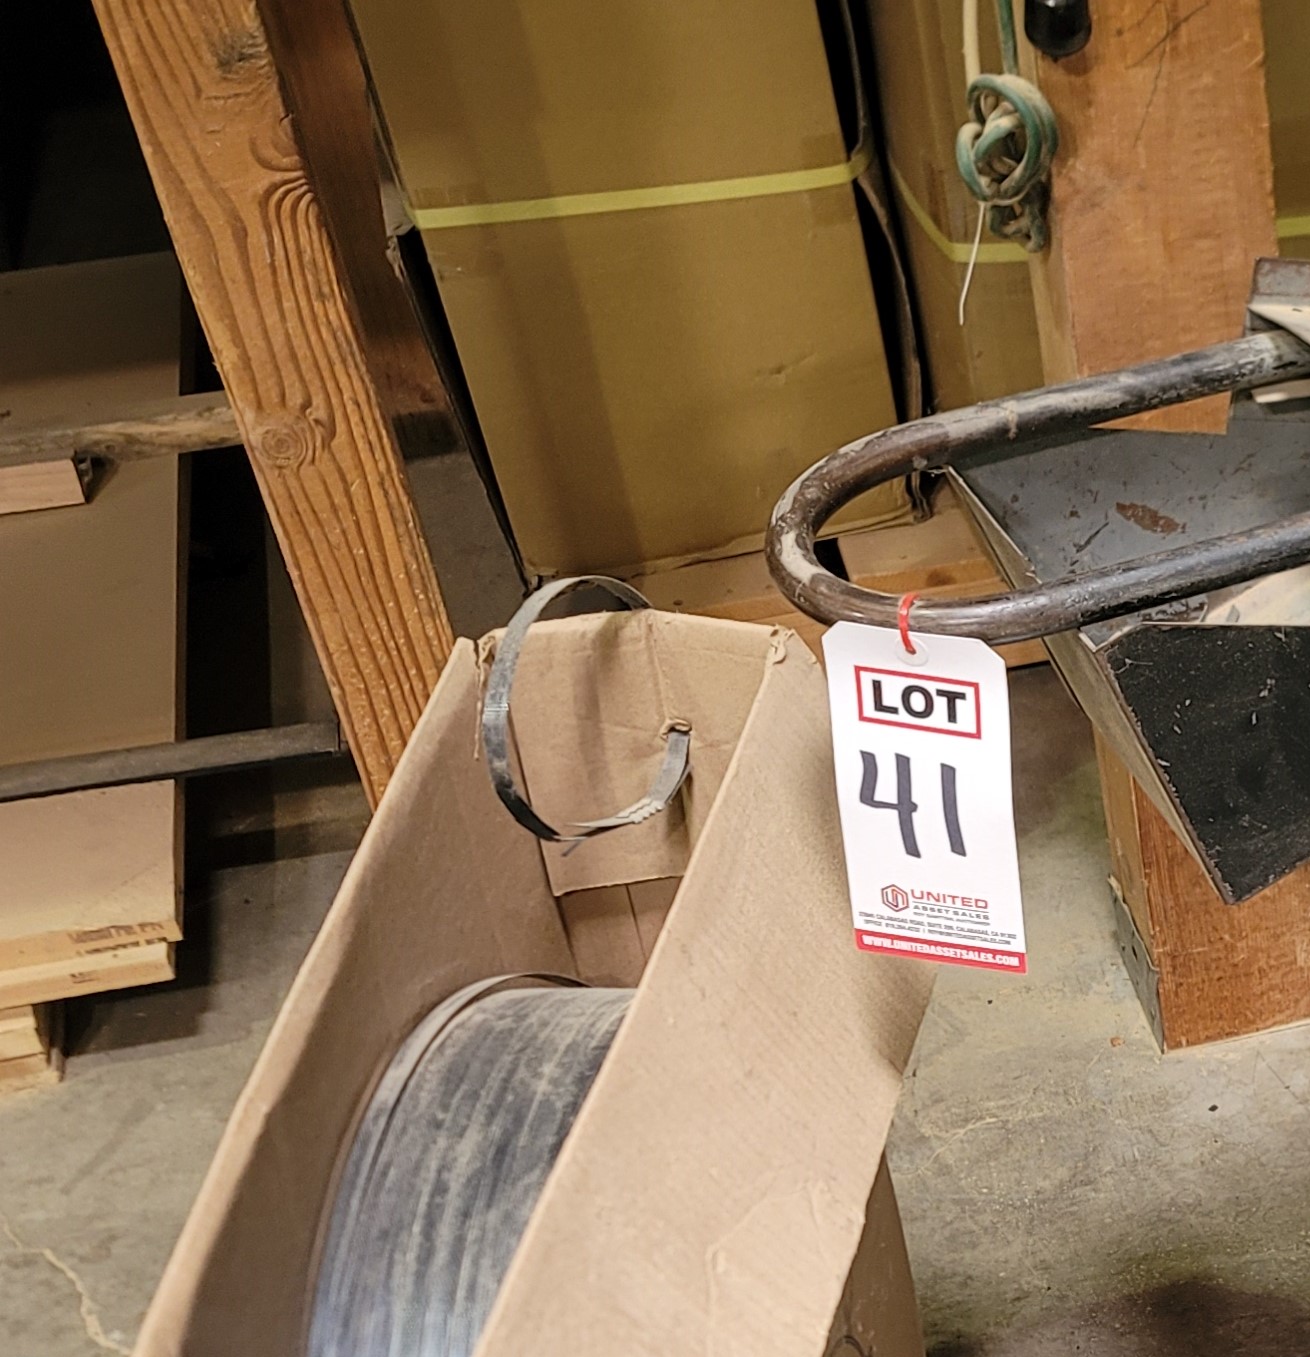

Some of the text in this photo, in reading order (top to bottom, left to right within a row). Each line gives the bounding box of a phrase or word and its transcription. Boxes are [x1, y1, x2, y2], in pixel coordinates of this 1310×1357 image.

[873, 680, 966, 724] LOT
[859, 750, 966, 858] 41
[911, 889, 988, 909] UNITED
[913, 904, 950, 914] ASSET
[952, 910, 990, 921] SALES
[862, 935, 1019, 966] WWW.UNITEDASSETSALES.COM
